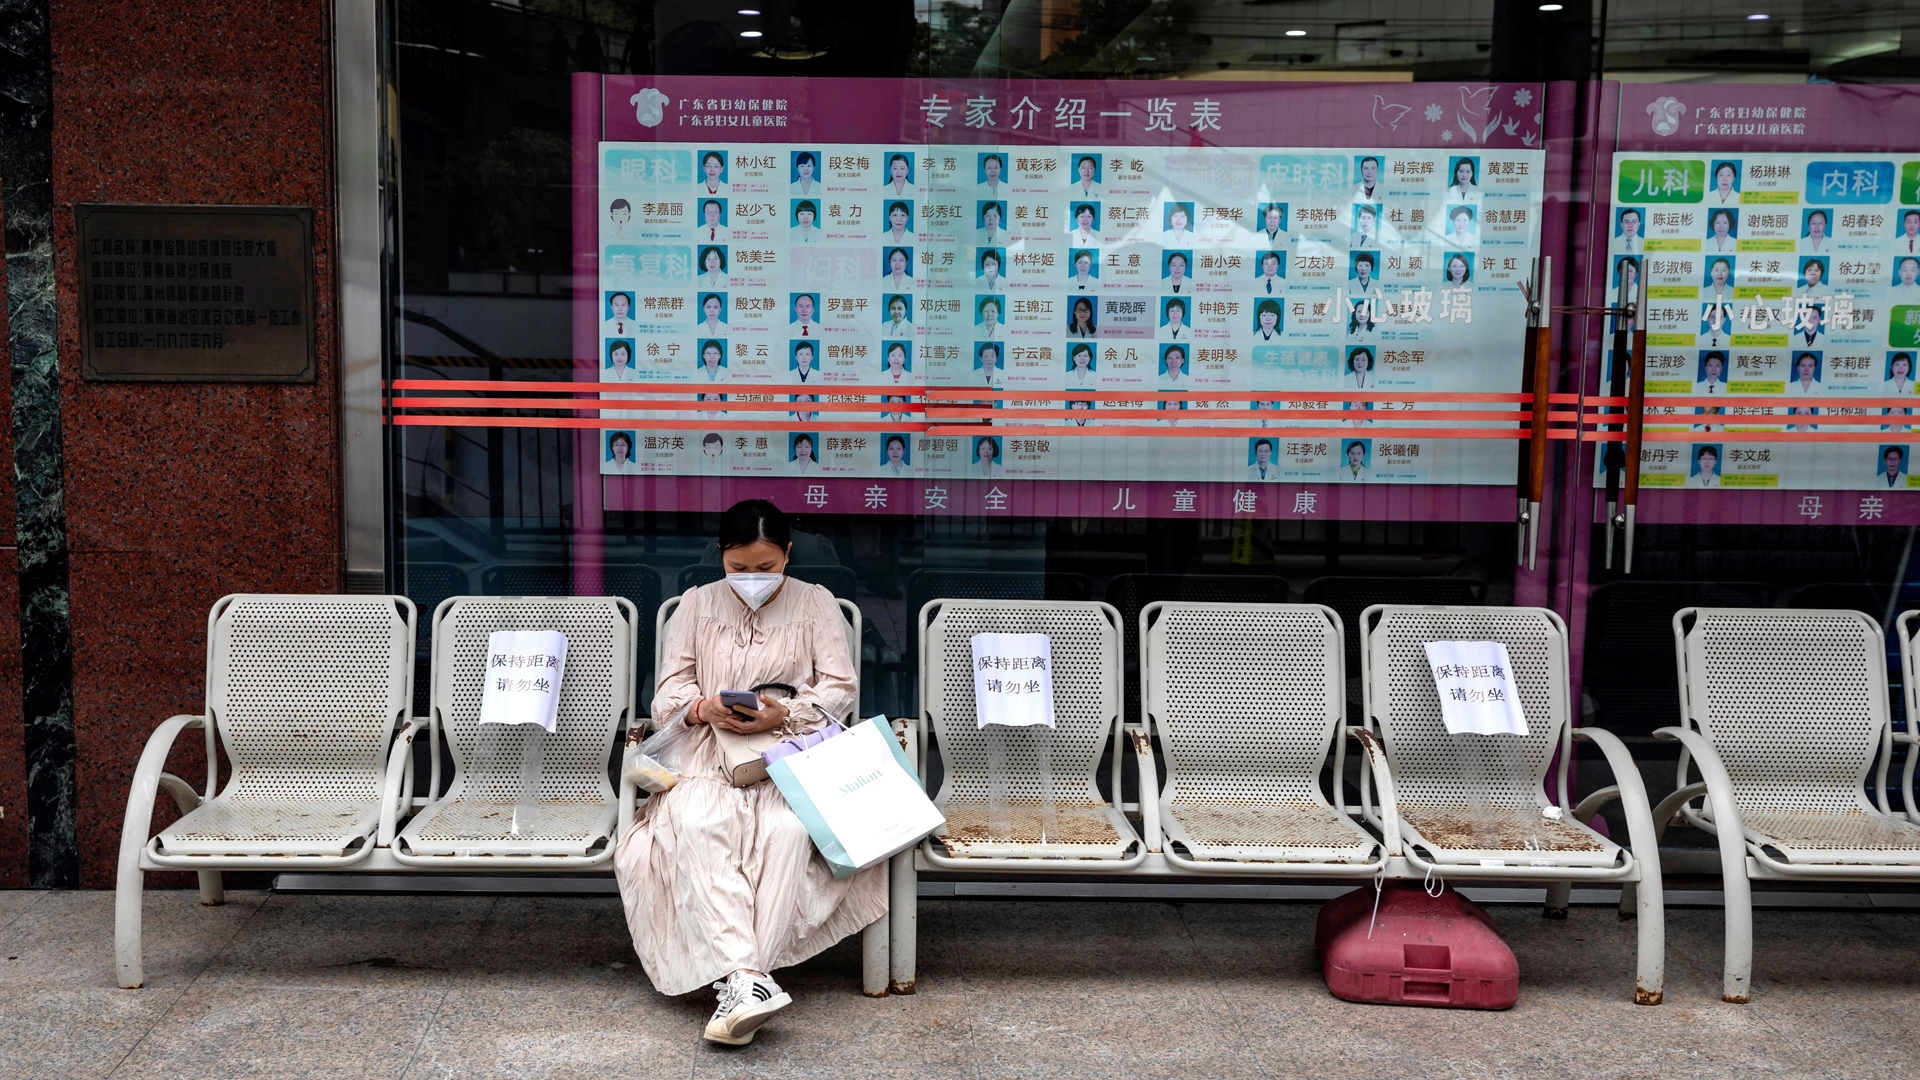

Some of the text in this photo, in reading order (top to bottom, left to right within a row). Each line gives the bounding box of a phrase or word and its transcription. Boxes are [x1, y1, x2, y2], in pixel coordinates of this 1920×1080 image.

[679, 99, 787, 110] 广东省妇幼保健院
[920, 94, 1222, 132] 专家介绍一览表
[1696, 107, 1806, 119] 广东省妇幼保健院
[679, 115, 787, 127] 广东省妇女儿童医院
[1695, 124, 1805, 135] 广东省妇女儿童医院
[736, 156, 776, 170] 林小红
[829, 157, 869, 170] 段冬梅
[923, 158, 956, 171] 李荔
[1016, 158, 1056, 171] 黄彩彩
[1110, 159, 1144, 172] 李屹
[1394, 161, 1434, 174] 肖宗辉
[1488, 162, 1529, 175] 黄翠玉
[620, 158, 676, 185] 眼科
[1266, 162, 1345, 190] 皮肤科
[1750, 165, 1791, 178] 杨琳琳
[1633, 169, 1689, 196] 儿科
[1823, 169, 1879, 196] 内科
[643, 203, 683, 215] 李嘉丽
[736, 203, 776, 216] 赵少飞
[829, 204, 861, 217] 袁力
[922, 205, 962, 218] 彭秀红
[1015, 206, 1048, 219] 姜红
[1108, 207, 1149, 220] 蔡仁燕
[1202, 207, 1243, 221] 尹爱华
[1296, 208, 1336, 221] 李晓伟
[1390, 209, 1424, 223] 杜鹏
[1485, 210, 1525, 223] 翁慧男
[1653, 213, 1693, 226] 陈运彬
[1748, 214, 1789, 228] 谢晓丽
[1842, 214, 1883, 227] 胡春玲
[736, 250, 776, 263] 饶美兰
[921, 252, 954, 265] 谢芳
[1014, 253, 1054, 266] 林华姬
[1107, 254, 1141, 267] 王意
[1201, 255, 1241, 268] 潘小英
[1294, 256, 1334, 269] 刁友涛
[1388, 256, 1422, 269] 刘颖
[613, 253, 688, 280] 康复科
[1483, 257, 1517, 270] 许虹
[1652, 261, 1692, 274] 彭淑梅
[1750, 260, 1780, 273] 朱波
[644, 297, 684, 309] 常燕群
[735, 297, 775, 310] 殷文静
[828, 298, 868, 311] 罗喜平
[920, 299, 960, 312] 邓庆珊
[1013, 300, 1053, 313] 王锦江
[1106, 301, 1146, 314] 黄晓晖
[1199, 302, 1239, 315] 钟艳芳
[1323, 285, 1473, 325] 小心玻璃
[1649, 308, 1688, 321] 王伟光
[1702, 292, 1855, 332] 小心玻璃
[647, 343, 680, 356] 徐宁
[735, 344, 768, 356] 黎云
[920, 346, 959, 359] 江雪芳
[1012, 347, 1052, 360] 宁云霞
[1105, 348, 1138, 360] 余凡
[1198, 349, 1237, 362] 麦明琴
[1264, 350, 1329, 365] 生殖健康
[1384, 350, 1424, 363] 苏念军
[1646, 355, 1685, 368] 王淑珍
[1737, 355, 1777, 368] 黄冬平
[1830, 356, 1871, 369] 李莉群
[644, 437, 684, 449] 温济英
[735, 437, 768, 449] 李惠
[827, 437, 866, 450] 薛素华
[918, 438, 957, 452] 廖碧翎
[1010, 440, 1050, 453] 李智敏
[1287, 443, 1327, 456] 汪李虎
[1730, 449, 1770, 462] 李文成
[804, 484, 1008, 510] 母亲安全
[1112, 488, 1317, 515] 儿童健康
[1798, 495, 1884, 520] 母亲
[491, 654, 560, 672] 保持距离
[977, 656, 1046, 671] 保持距离
[1435, 664, 1506, 680] 保持距离
[496, 678, 550, 694] 请勿坐
[986, 679, 1041, 694] 请勿坐
[1449, 687, 1506, 703] 请勿坐
[838, 769, 883, 797] Malian
